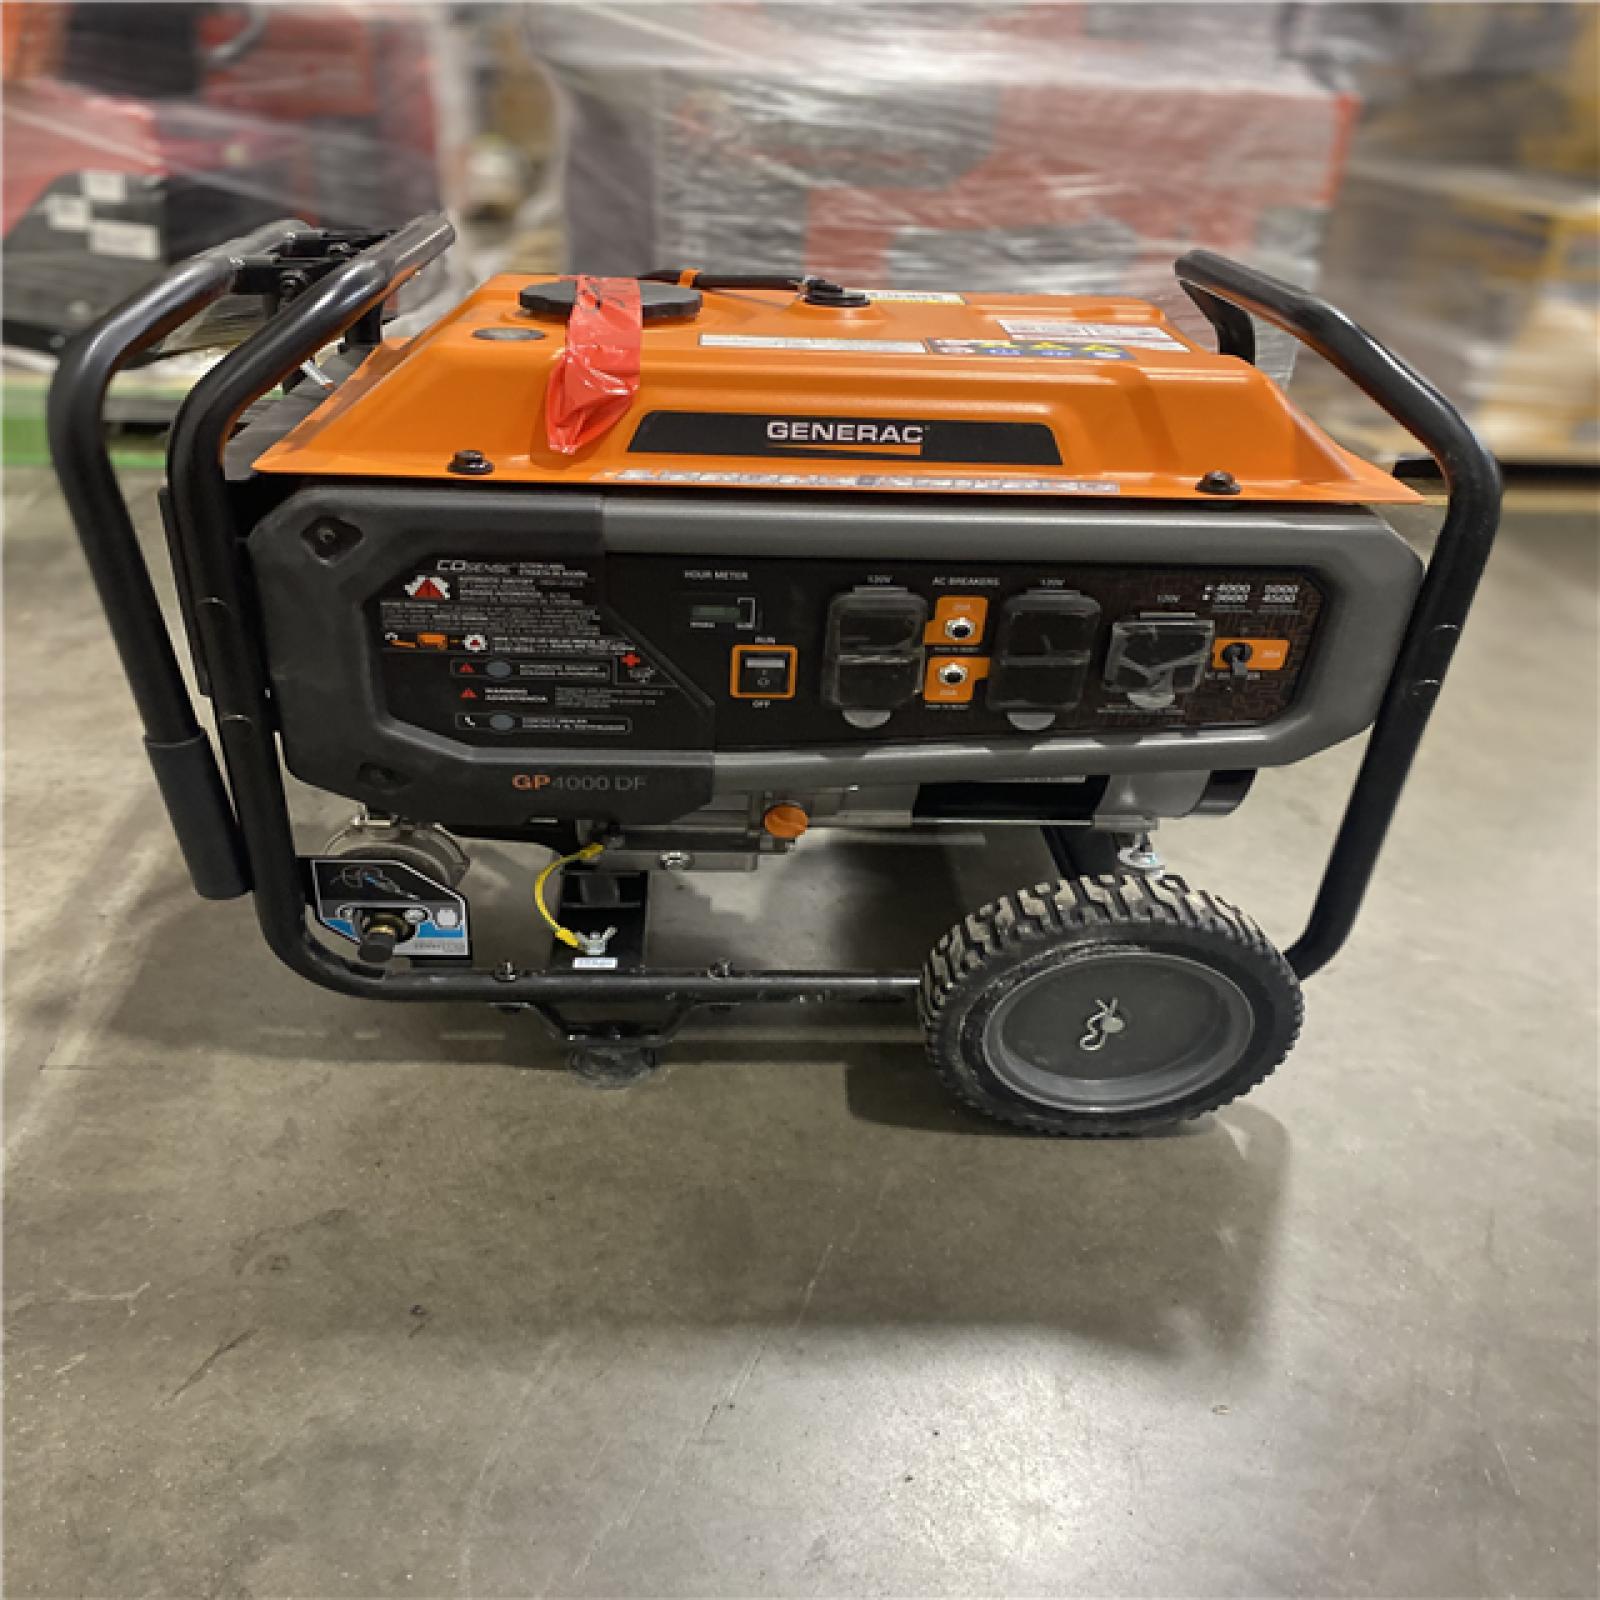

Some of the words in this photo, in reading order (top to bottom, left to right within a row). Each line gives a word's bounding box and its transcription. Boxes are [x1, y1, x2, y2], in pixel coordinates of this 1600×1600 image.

[766, 421, 923, 444] GENERAC
[683, 570, 713, 580] HOUR
[714, 570, 749, 581] METER
[931, 576, 947, 587] AC
[948, 576, 1001, 587] BREAKERS
[751, 699, 771, 709] OFF
[614, 775, 647, 792] DF
